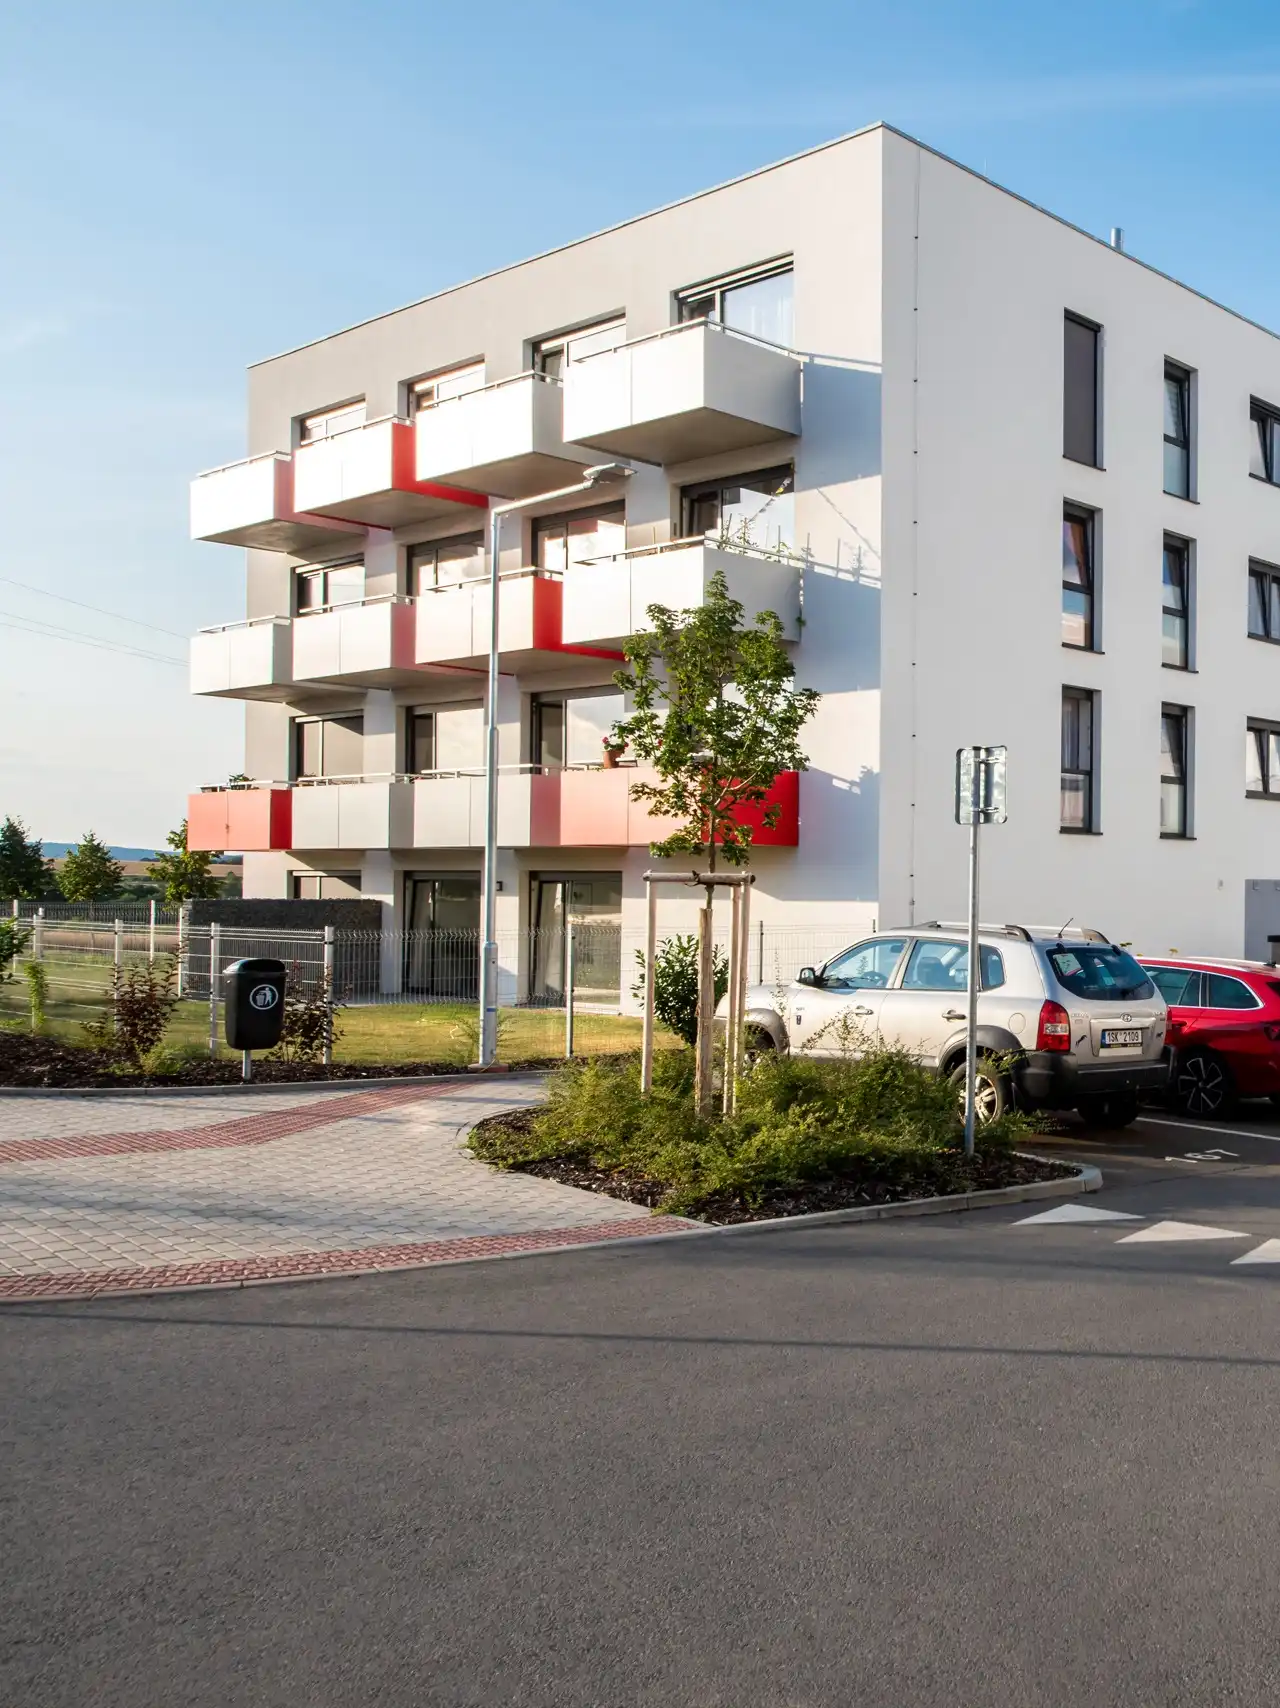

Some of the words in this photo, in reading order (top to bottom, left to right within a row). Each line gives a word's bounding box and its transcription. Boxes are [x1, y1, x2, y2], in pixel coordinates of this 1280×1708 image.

[1107, 1032, 1118, 1042] 1SK
[1123, 1031, 1139, 1042] 2109
[1164, 1148, 1240, 1163] 167
